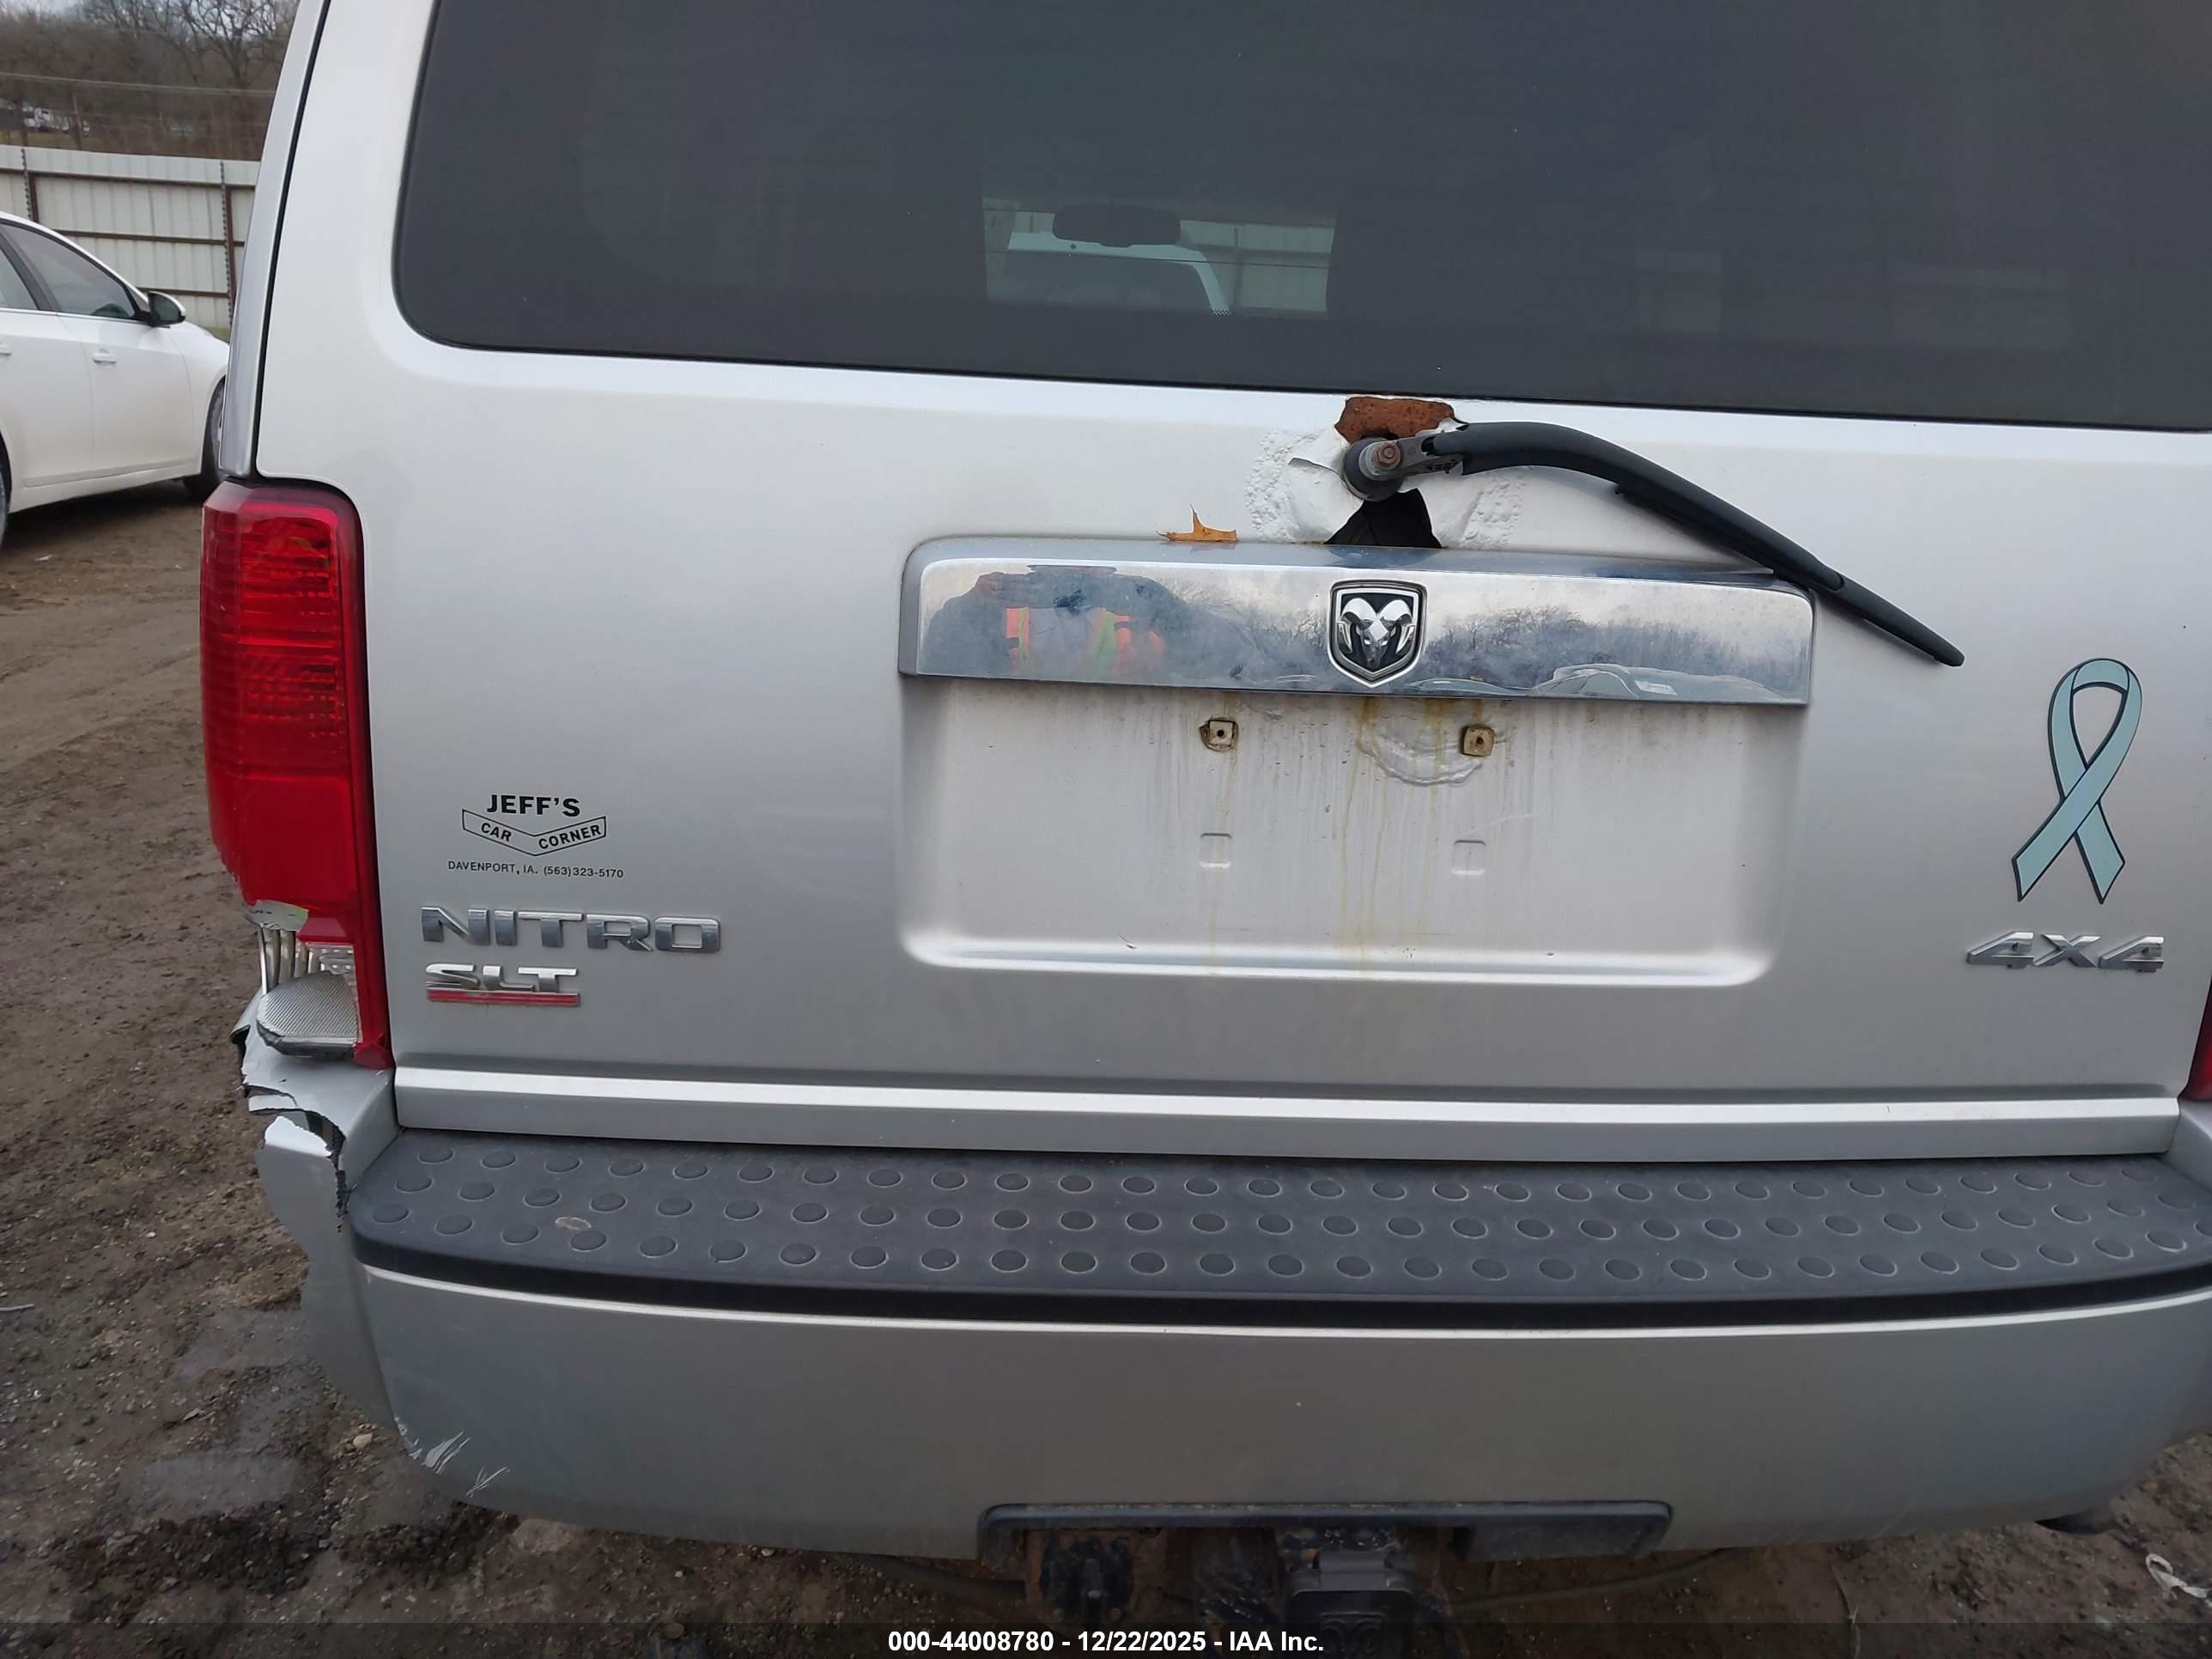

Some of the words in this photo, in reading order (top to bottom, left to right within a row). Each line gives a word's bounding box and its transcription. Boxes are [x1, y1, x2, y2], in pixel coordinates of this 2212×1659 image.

[487, 794, 580, 817] JEFF'S
[481, 823, 512, 842] CAR
[538, 824, 602, 850] CORNER
[447, 860, 520, 876] DAVENPORT,
[523, 864, 538, 875] IA.
[543, 866, 624, 878] (563)323-5170
[421, 906, 721, 952] NITRO
[425, 963, 578, 993] SLT
